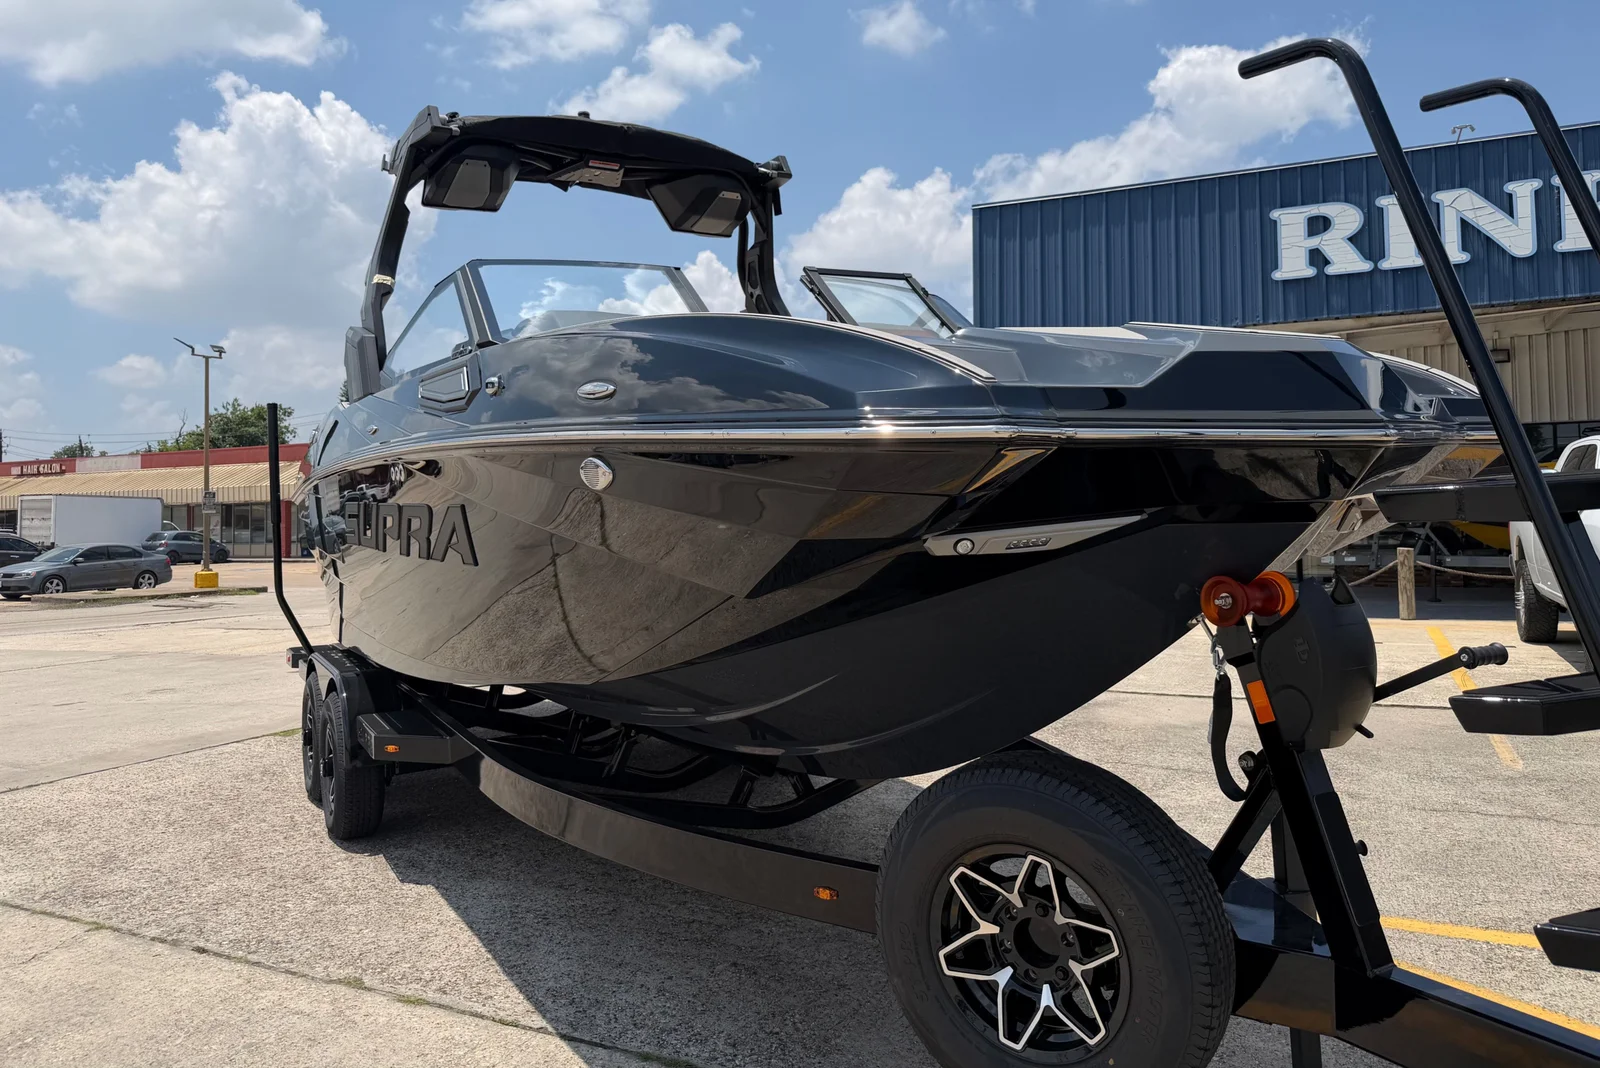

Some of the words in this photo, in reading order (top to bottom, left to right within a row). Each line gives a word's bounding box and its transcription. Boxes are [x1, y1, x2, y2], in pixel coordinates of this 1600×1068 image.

[1269, 170, 1600, 281] RIN
[22, 465, 38, 475] HAIR
[39, 463, 61, 474] SALON
[345, 501, 479, 567] SUPRA
